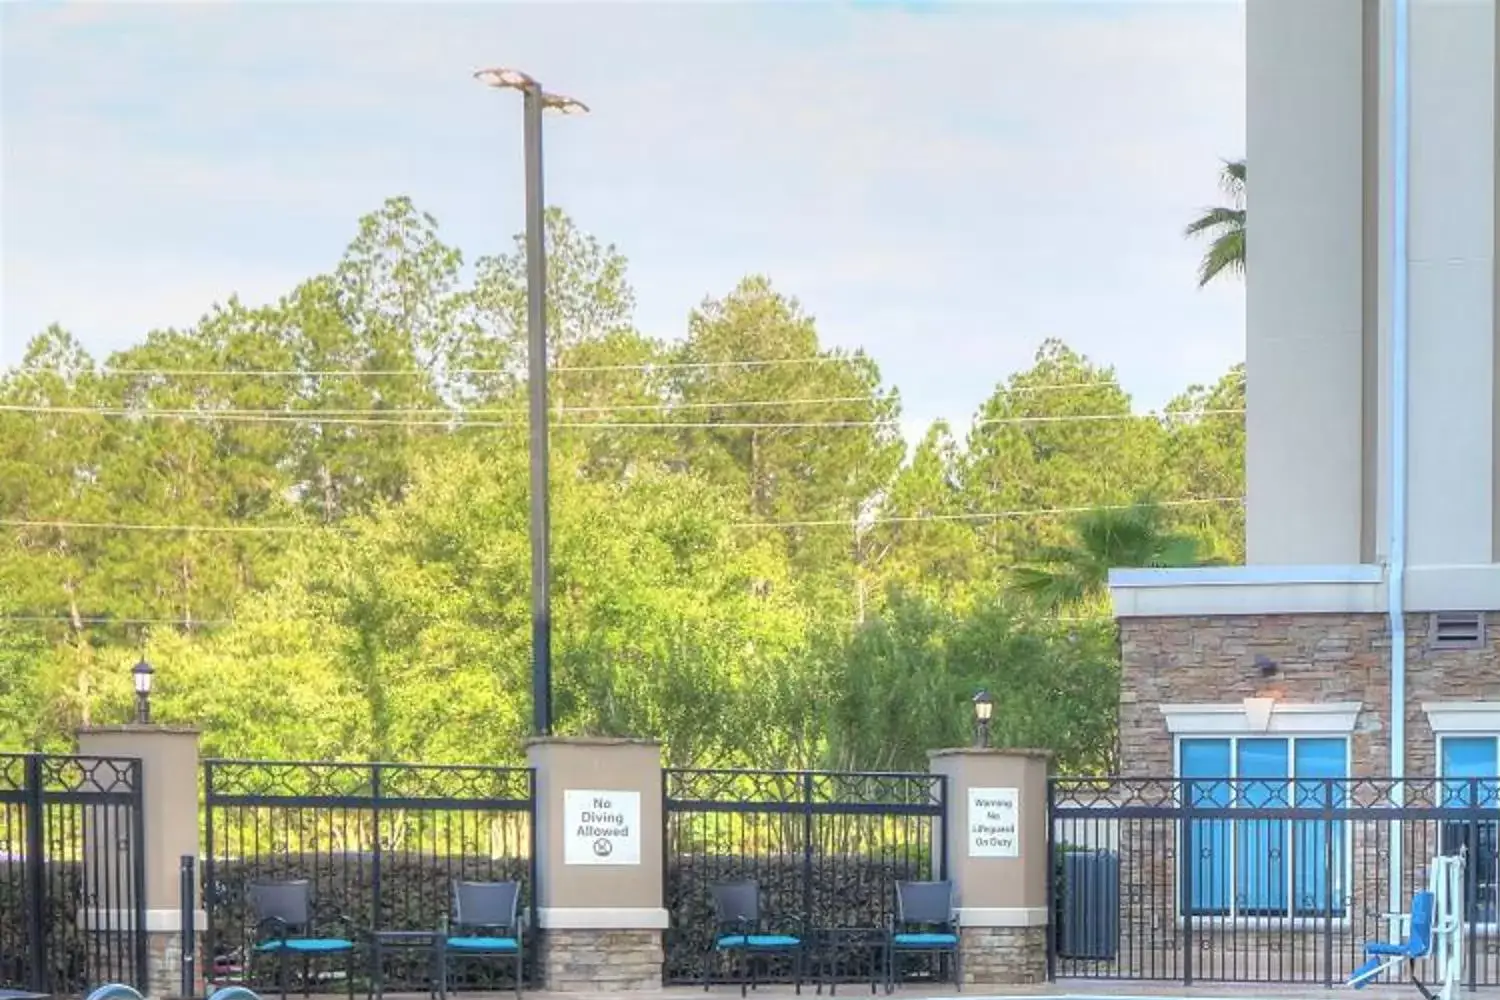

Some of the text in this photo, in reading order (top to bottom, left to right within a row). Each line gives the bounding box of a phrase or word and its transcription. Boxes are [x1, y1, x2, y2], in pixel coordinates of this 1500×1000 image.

[593, 797, 612, 809] No
[581, 811, 624, 826] Diving
[987, 811, 1001, 820] No
[577, 825, 629, 837] Allowed
